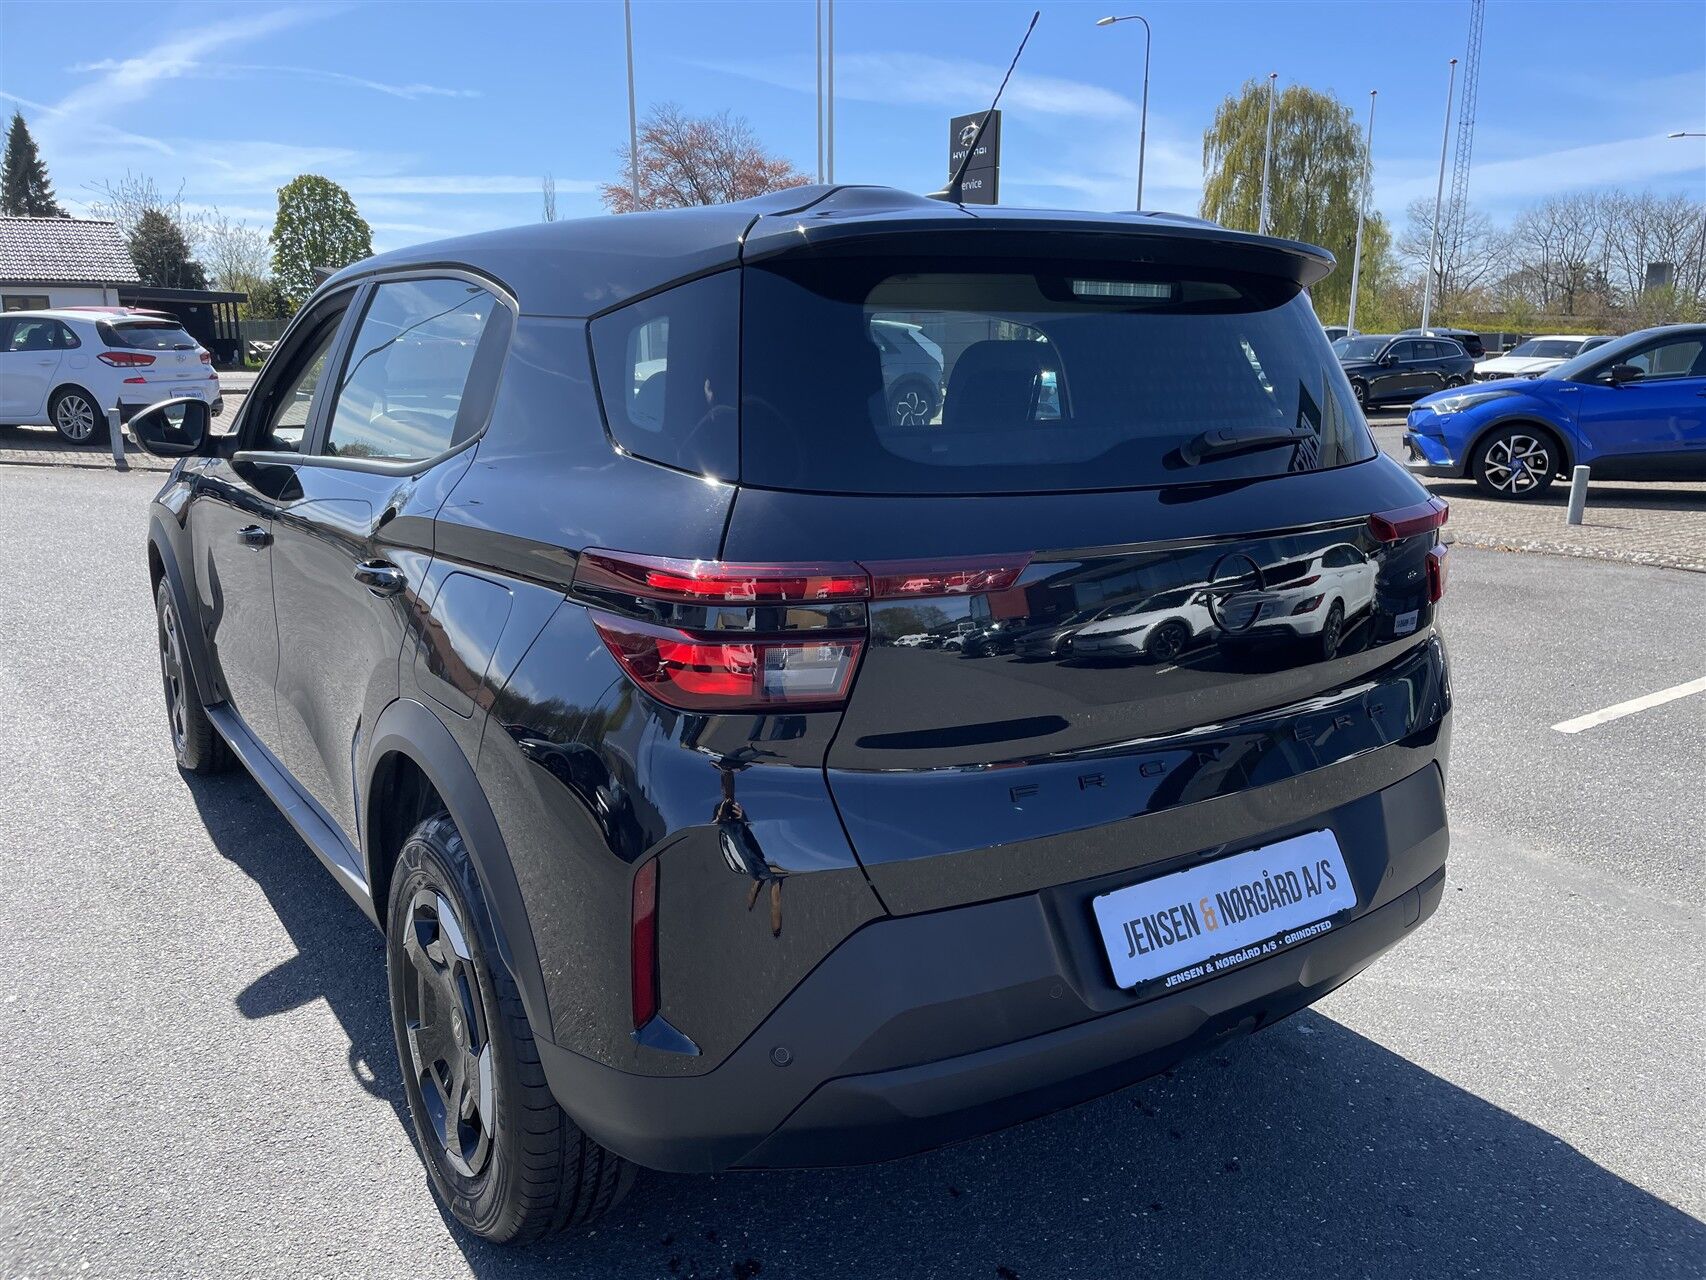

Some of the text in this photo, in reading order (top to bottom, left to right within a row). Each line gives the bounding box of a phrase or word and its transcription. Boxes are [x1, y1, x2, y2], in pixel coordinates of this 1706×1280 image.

[953, 147, 987, 159] HYUDAI
[961, 179, 982, 190] ervice
[1009, 703, 1386, 802] FRONTERA
[1123, 859, 1337, 958] JENSEN & NØRGÅRD A/S
[1165, 920, 1332, 988] JENSEN & NØRGÅRD A/S GRINDSTED
